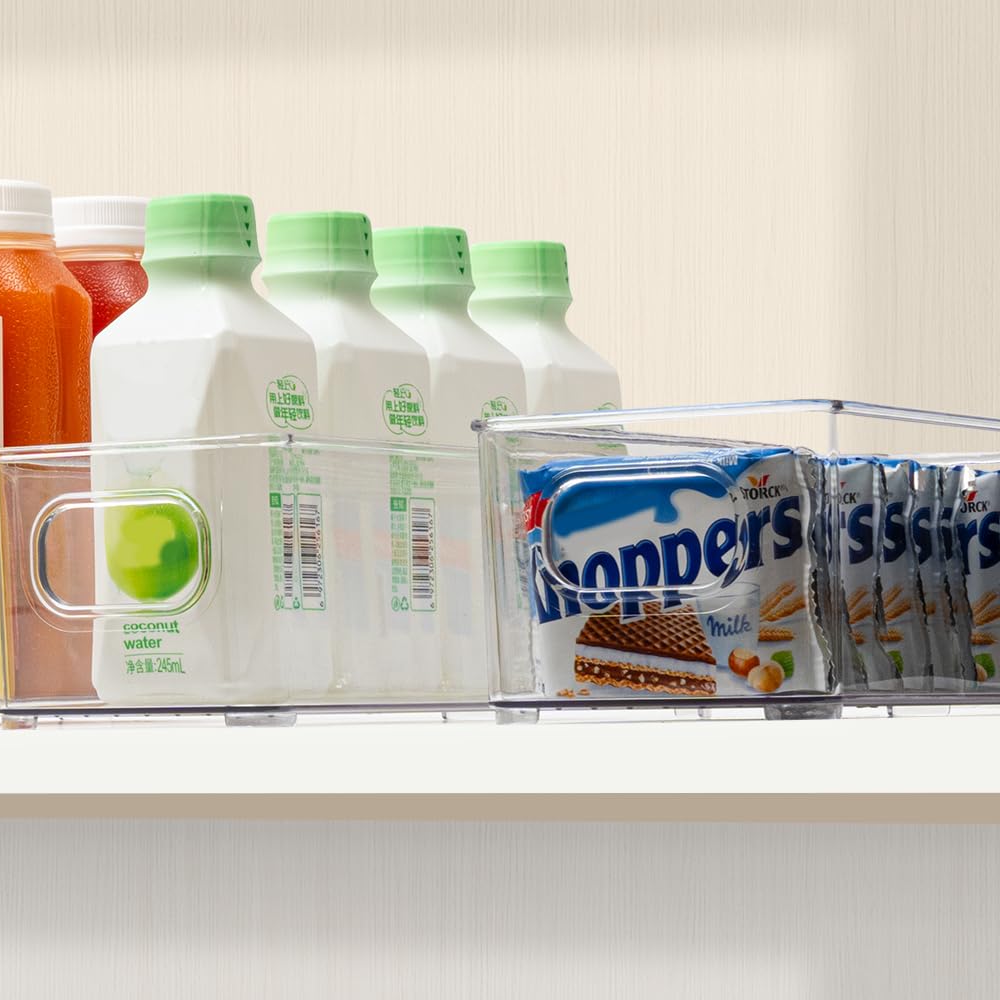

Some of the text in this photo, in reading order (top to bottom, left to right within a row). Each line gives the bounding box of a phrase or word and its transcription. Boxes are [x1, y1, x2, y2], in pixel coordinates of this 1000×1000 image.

[960, 501, 988, 514] ORCK
[123, 619, 180, 635] coconut
[123, 635, 163, 650] water
